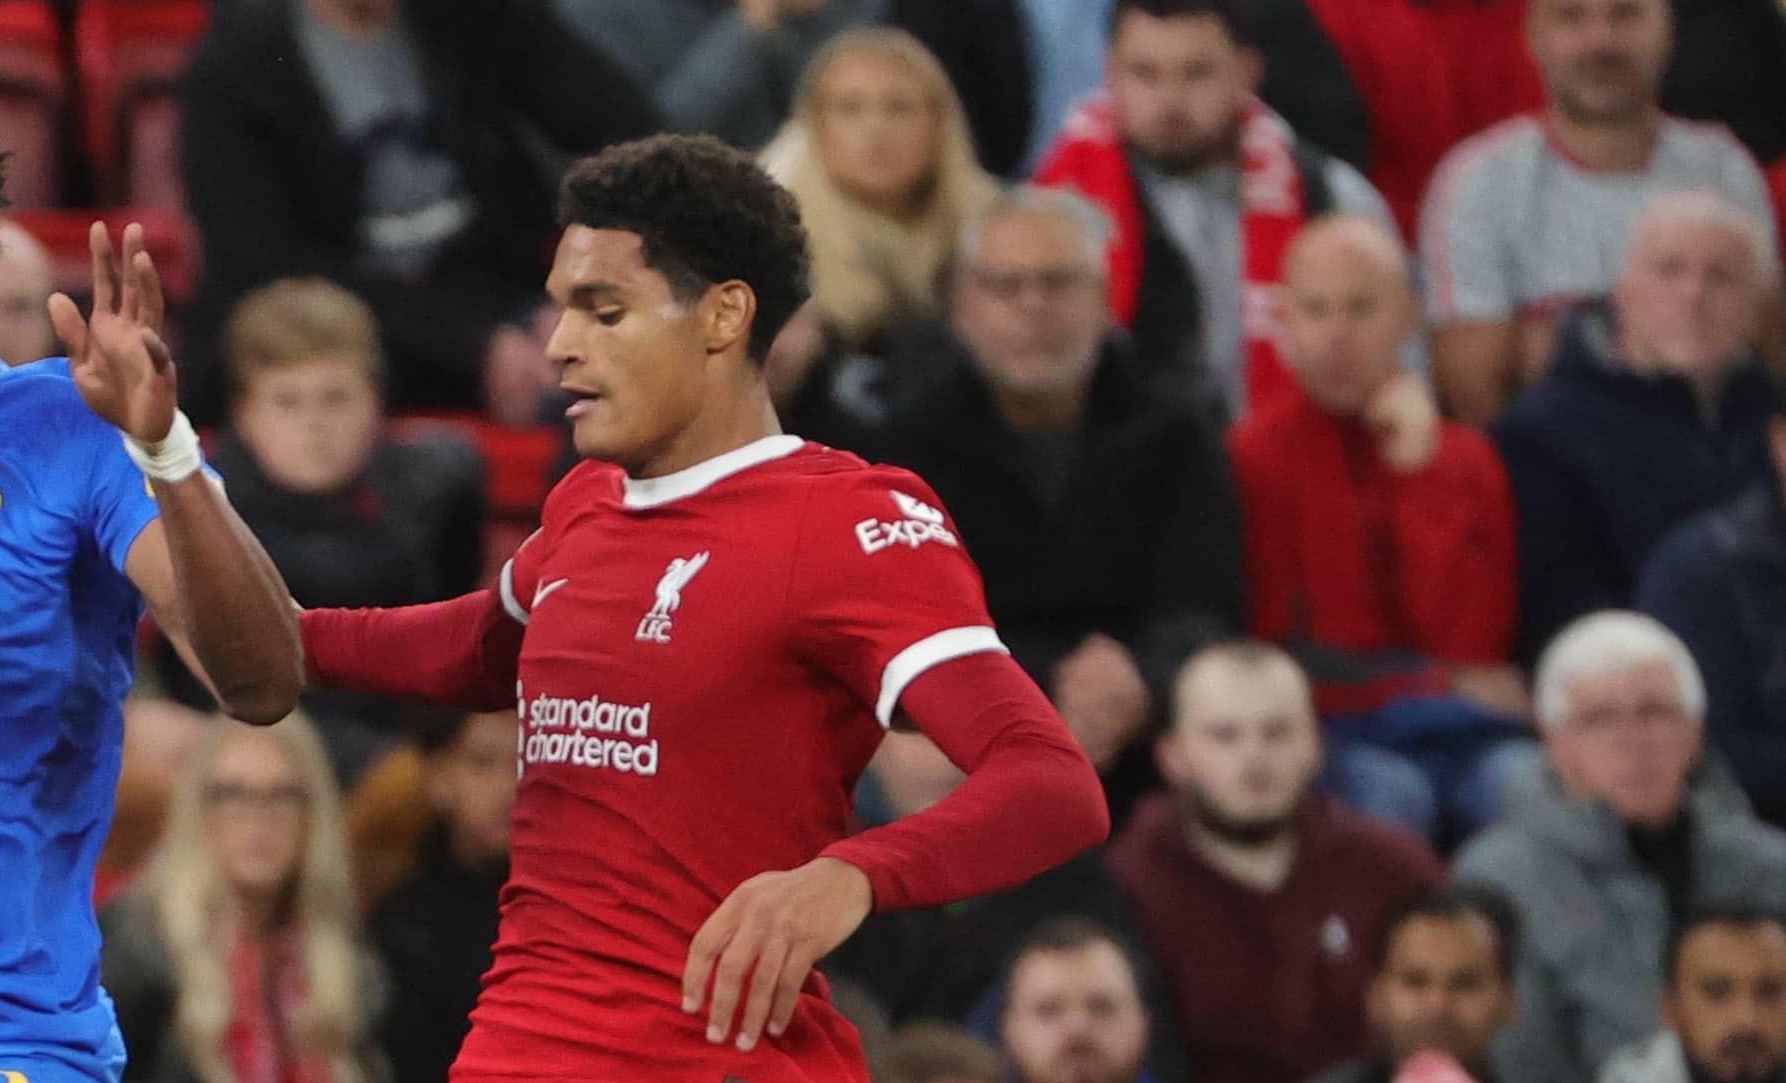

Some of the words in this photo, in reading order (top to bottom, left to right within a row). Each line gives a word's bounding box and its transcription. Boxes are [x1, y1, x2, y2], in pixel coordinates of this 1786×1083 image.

[634, 618, 673, 643] LFC
[529, 693, 651, 738] standard
[525, 729, 659, 776] chartered
